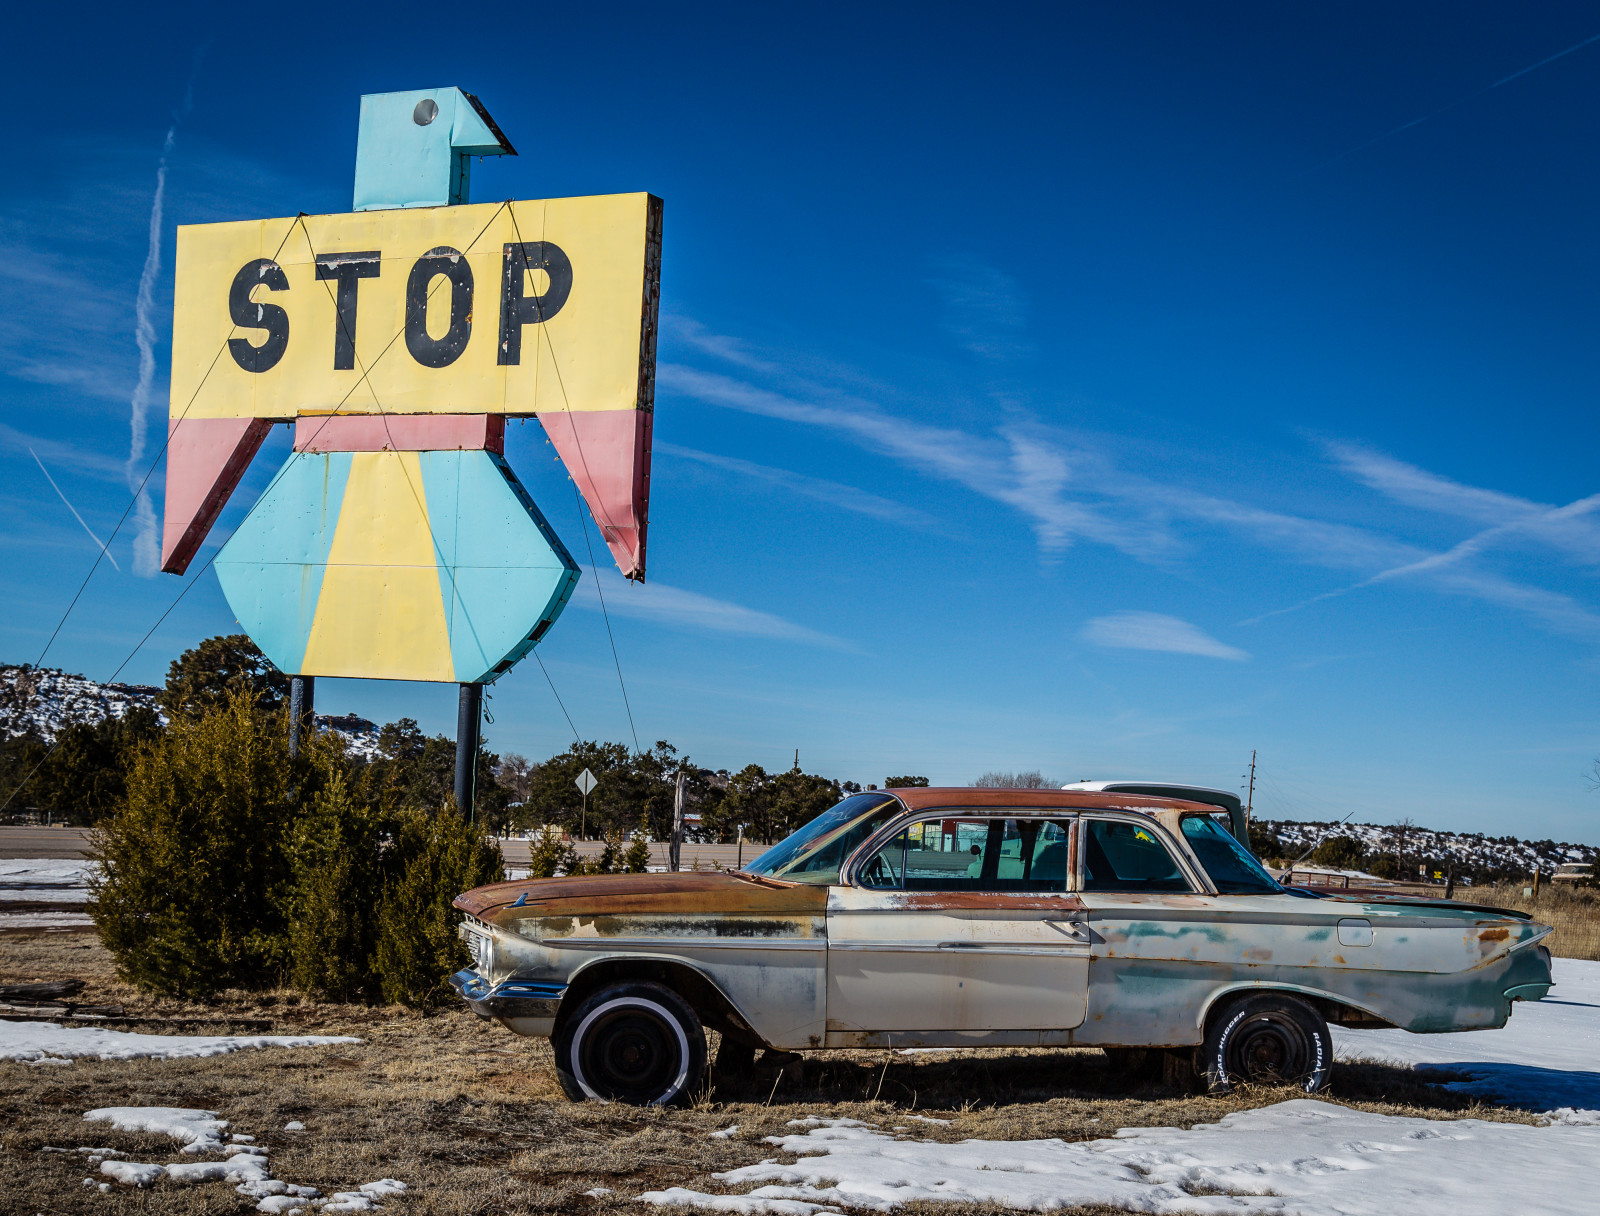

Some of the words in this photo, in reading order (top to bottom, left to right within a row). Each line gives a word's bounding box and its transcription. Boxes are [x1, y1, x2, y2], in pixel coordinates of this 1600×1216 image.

[228, 241, 573, 373] STOP
[1218, 1011, 1246, 1050] HUGGER
[1217, 1054, 1228, 1084] ROAD
